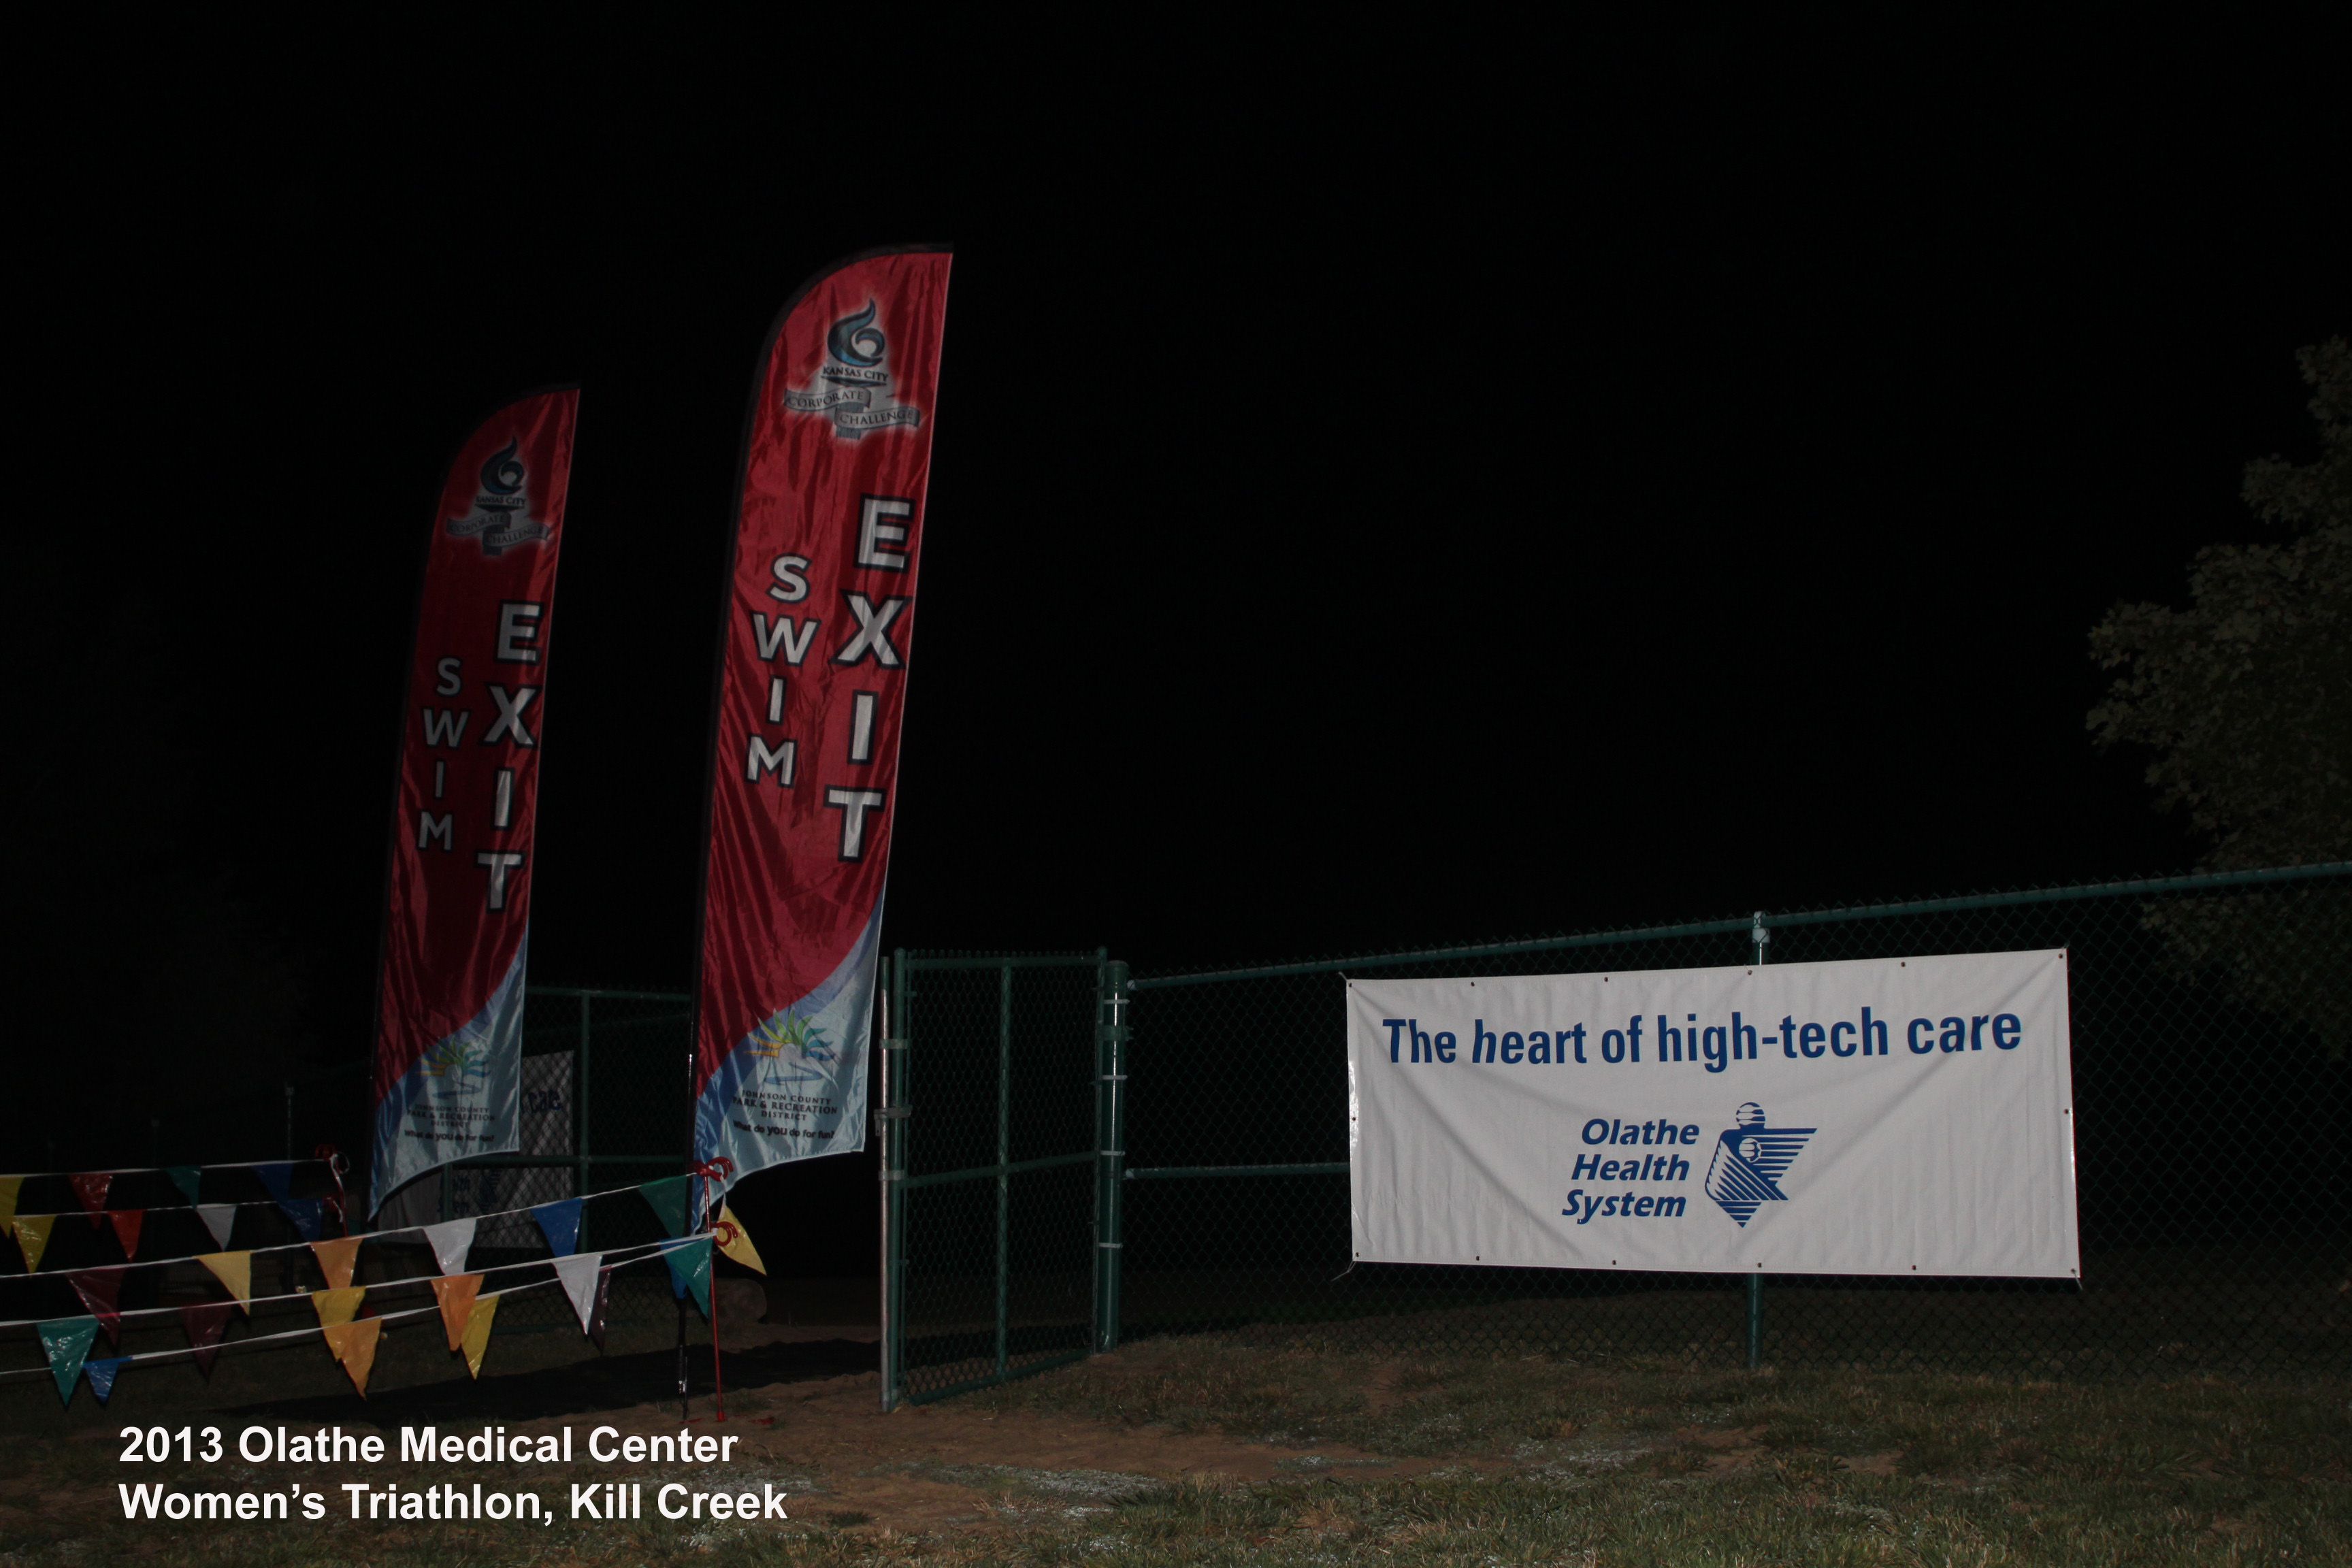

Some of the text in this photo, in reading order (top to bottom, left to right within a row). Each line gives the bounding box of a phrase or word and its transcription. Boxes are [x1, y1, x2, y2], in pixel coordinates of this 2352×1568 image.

[823, 366, 889, 381] KANSAS CITY
[787, 390, 864, 407] CORPORATE
[840, 410, 913, 425] CHALLENGE
[477, 495, 526, 506] KANSAS CITY
[450, 514, 505, 533] CORPORATE
[487, 525, 543, 544] CHALLENGE
[746, 553, 820, 787] SWIM
[824, 494, 913, 862] EXIT
[417, 656, 470, 851] SWIM
[476, 601, 542, 913] EXIT
[1382, 1007, 2023, 1073] The heart of high-tech care
[732, 1096, 838, 1114] PARK & RECREATION
[742, 1090, 831, 1105] JOHNSON COUNTY
[440, 1112, 495, 1122] RECREATION
[761, 1110, 806, 1120] DISTRICT
[436, 1133, 453, 1142] you
[754, 1124, 764, 1133] do
[767, 1126, 787, 1136] you
[789, 1128, 800, 1137] do
[803, 1130, 816, 1138] for
[818, 1130, 834, 1139] fun?
[1582, 1118, 1699, 1146] Olathe
[1572, 1154, 1690, 1181] Health
[1563, 1189, 1686, 1226] System
